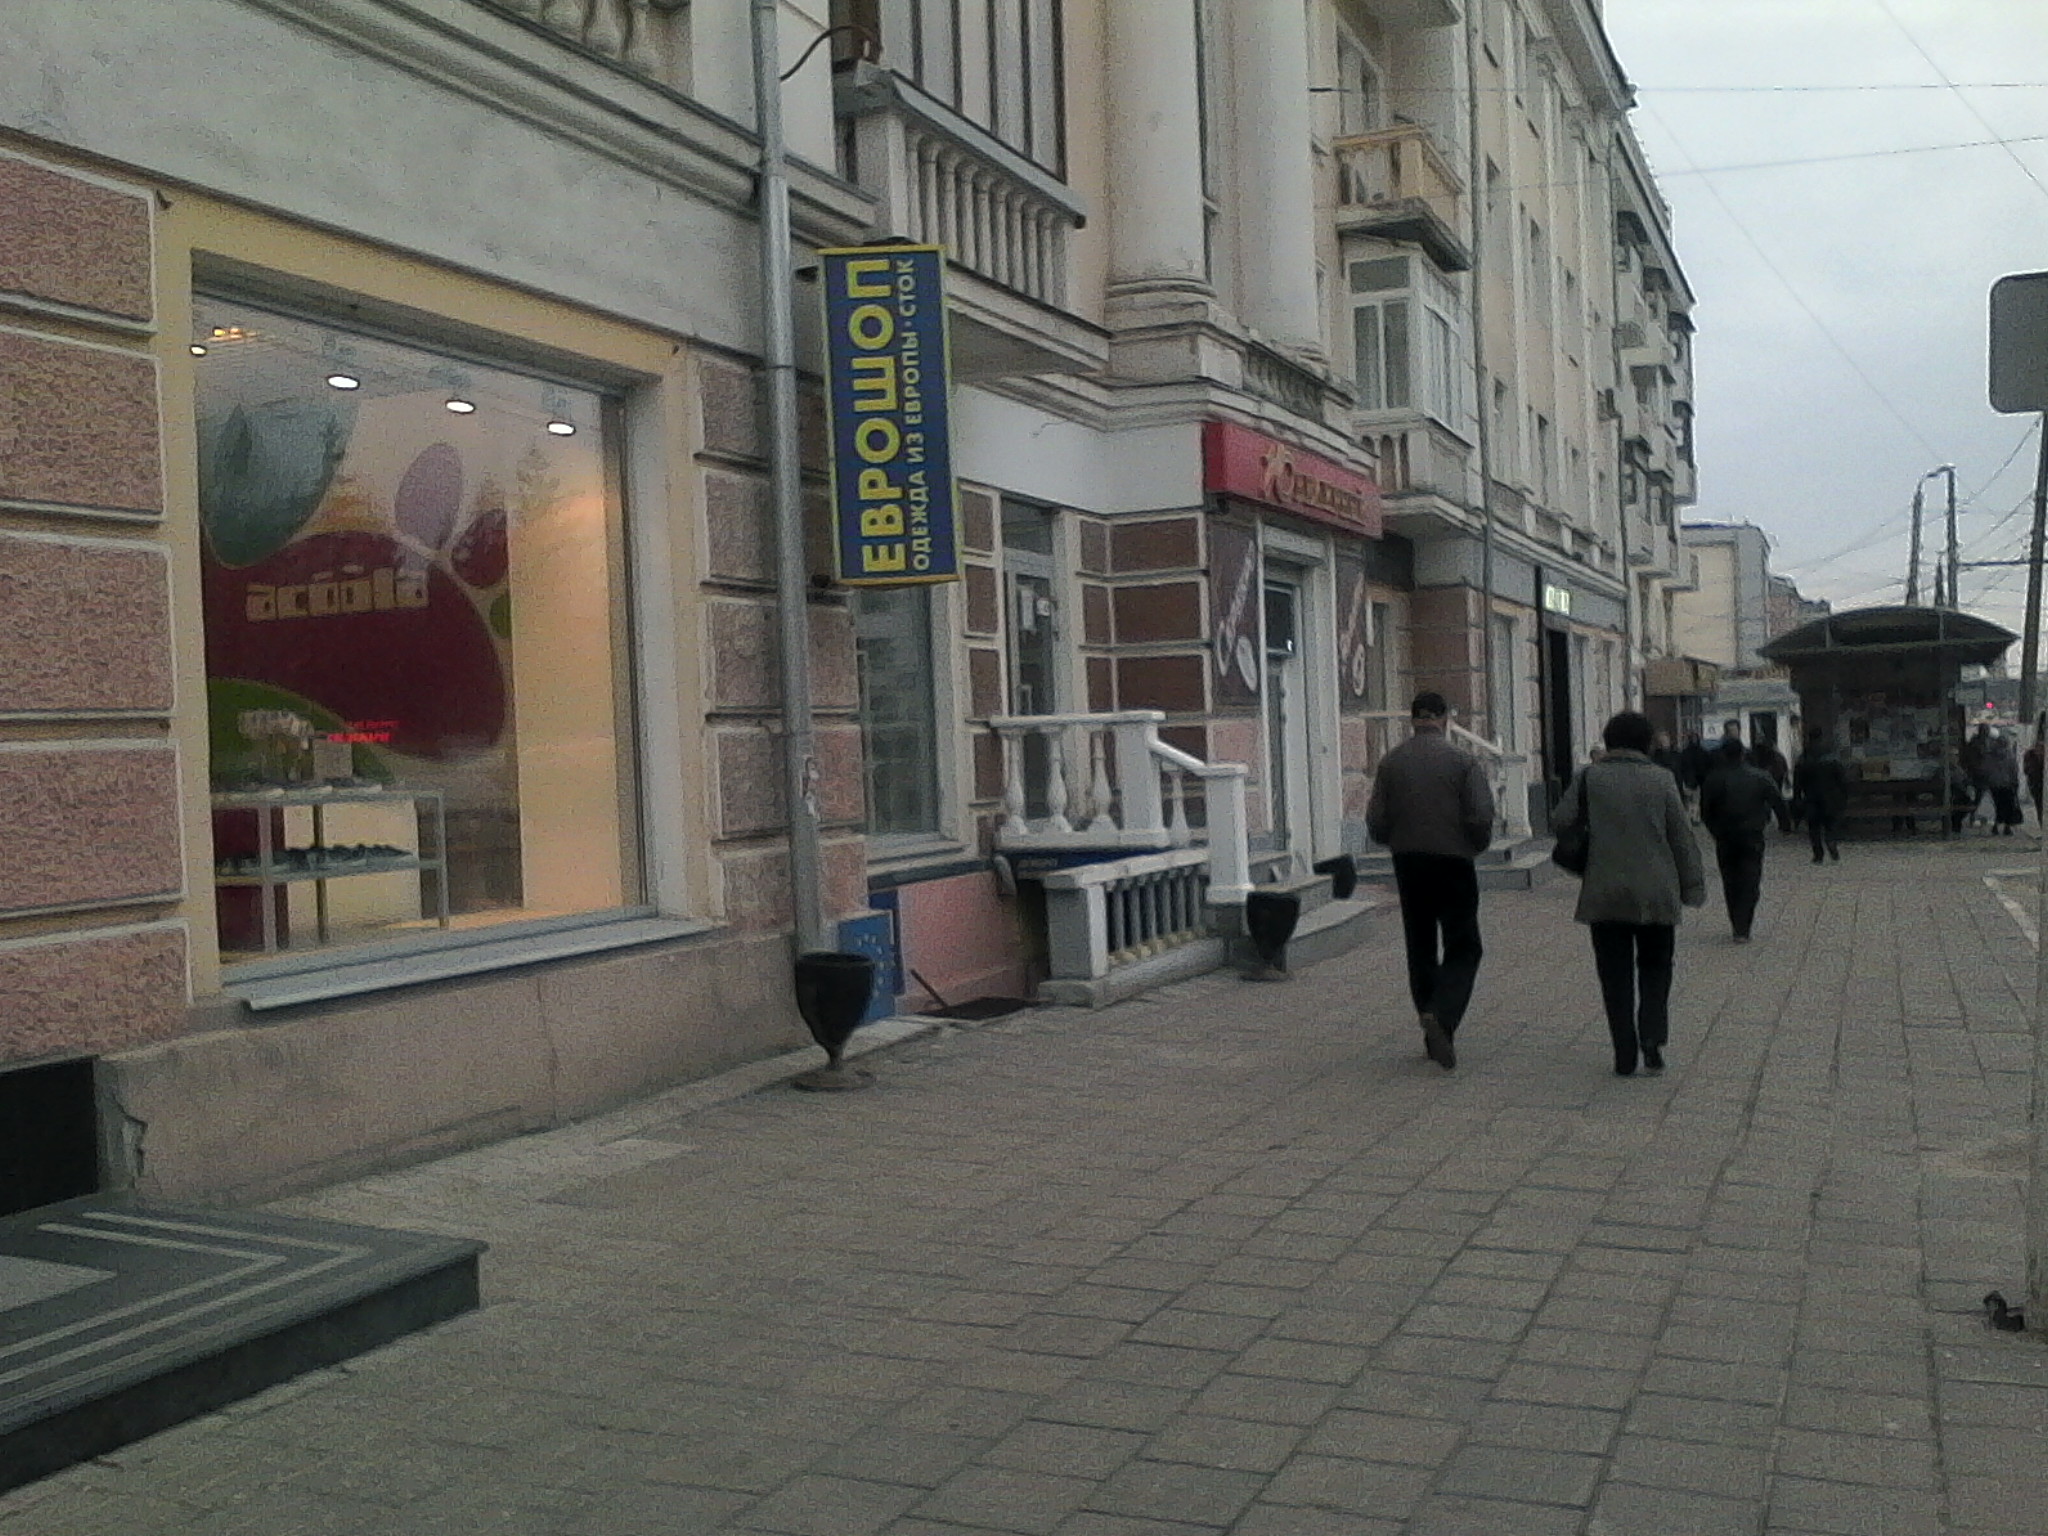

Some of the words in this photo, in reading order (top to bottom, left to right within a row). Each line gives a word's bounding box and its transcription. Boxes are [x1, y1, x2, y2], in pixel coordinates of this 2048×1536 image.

[898, 257, 917, 318] СТОК
[846, 258, 907, 573] ЕВРОШОП
[902, 330, 922, 426] ЕВРОПЫ
[906, 435, 926, 464] ИЗ
[908, 468, 931, 572] ОДЕЖДА
